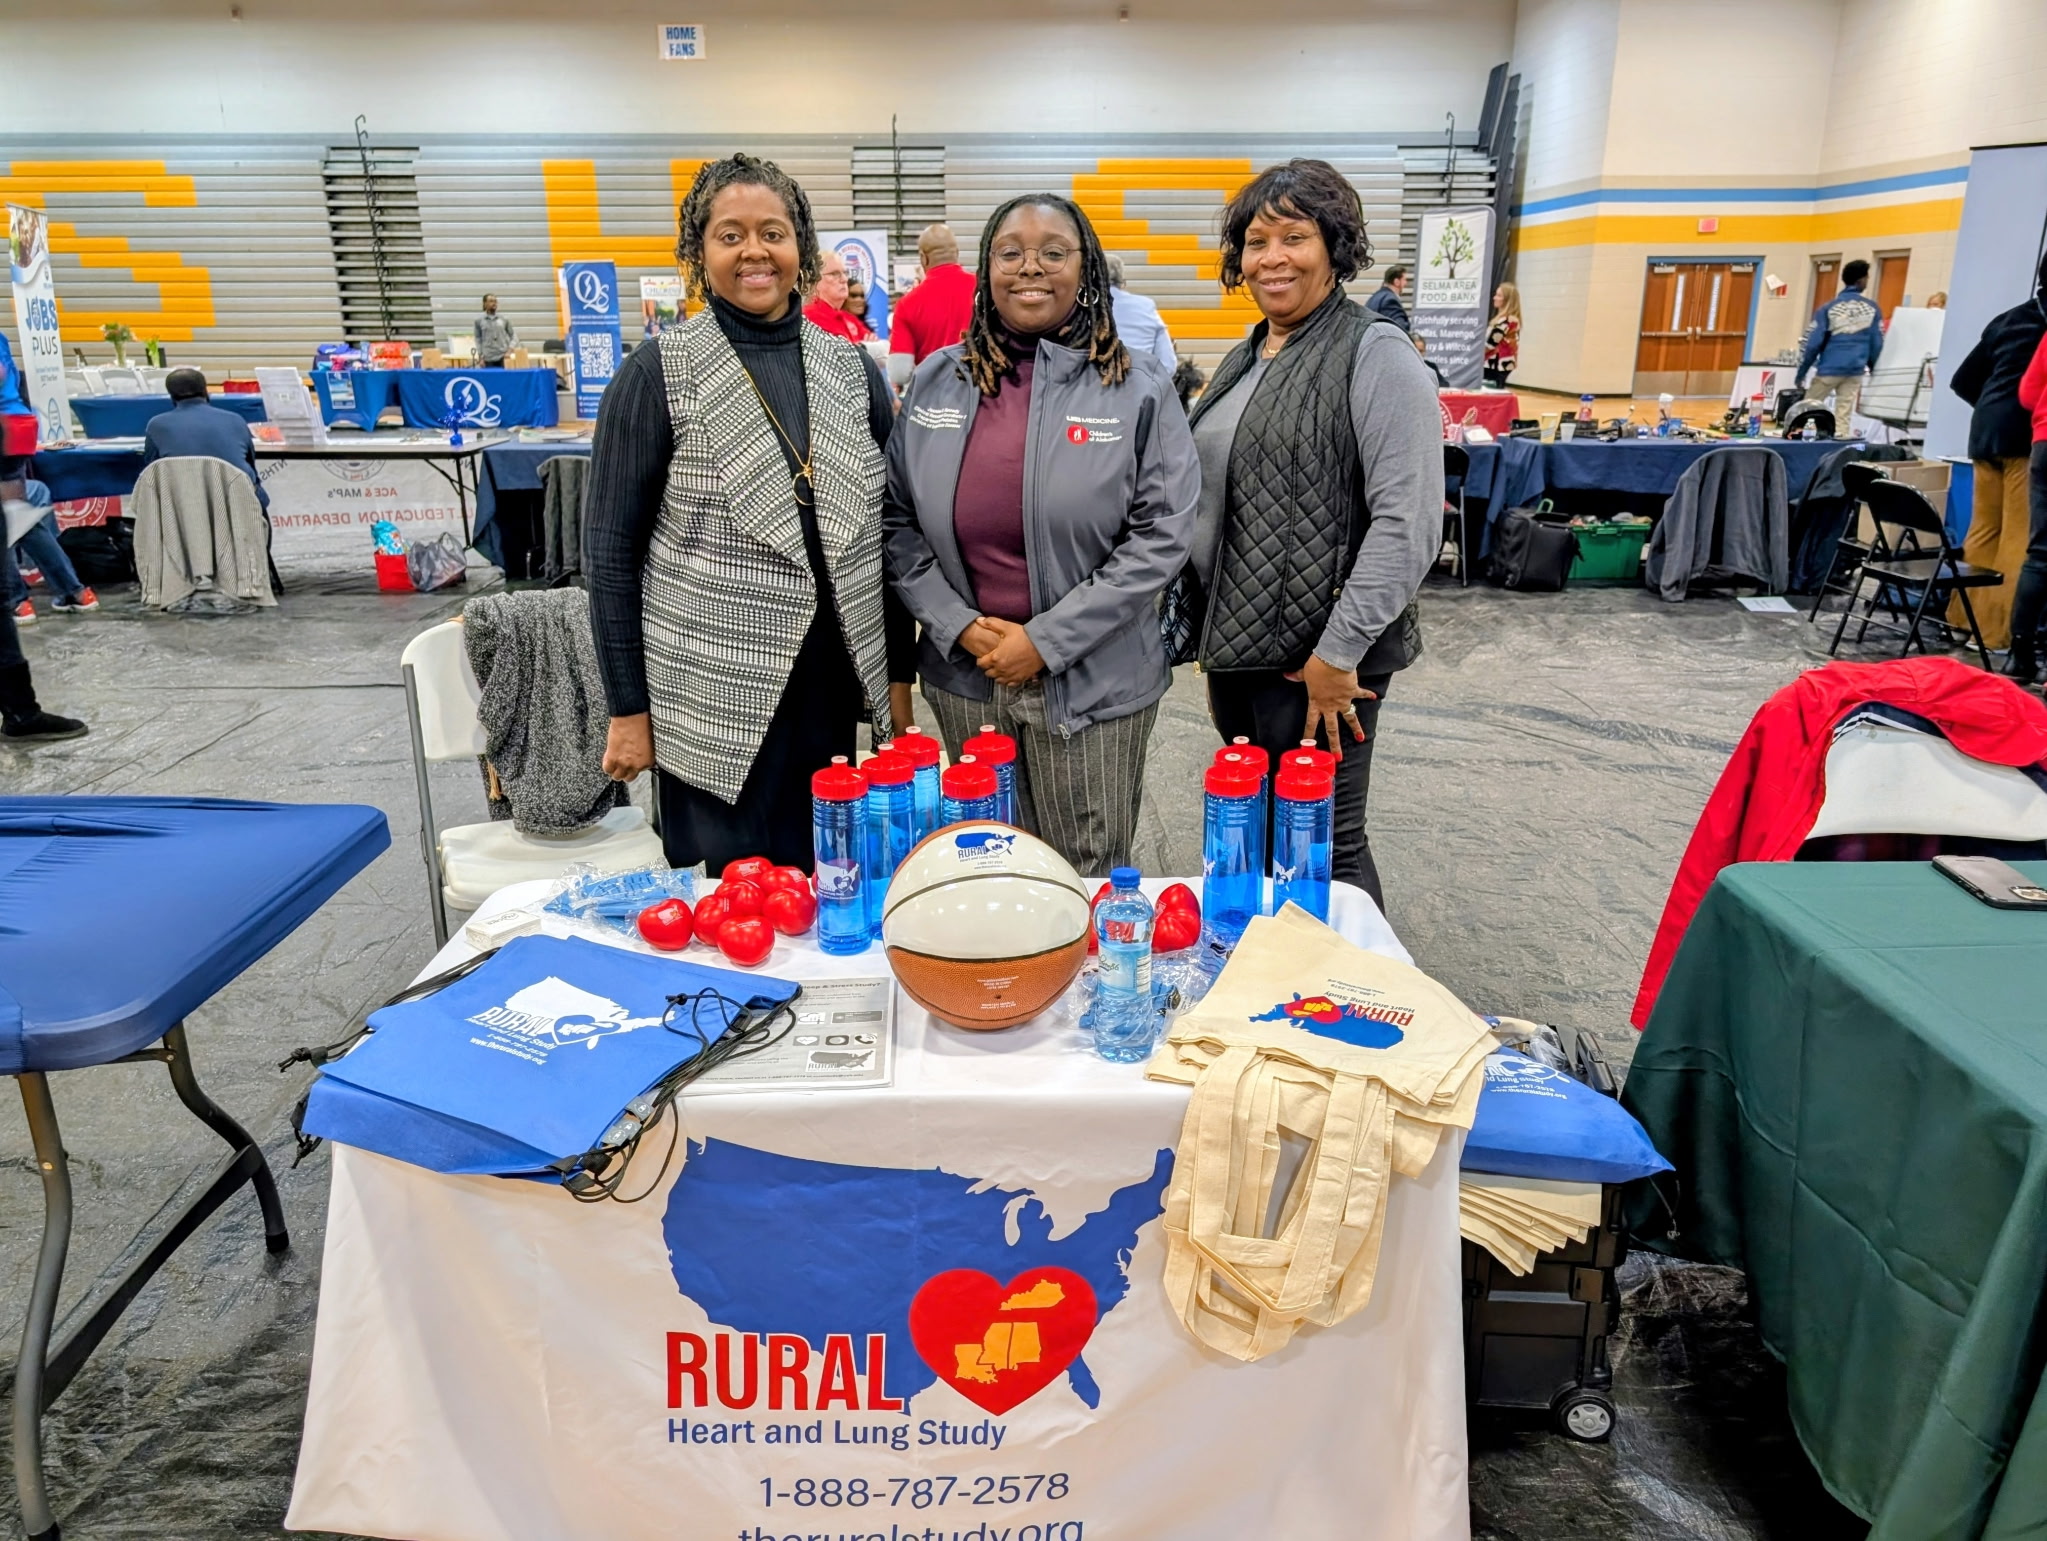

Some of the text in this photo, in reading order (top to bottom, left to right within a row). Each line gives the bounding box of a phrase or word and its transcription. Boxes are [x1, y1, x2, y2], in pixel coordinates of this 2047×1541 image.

[666, 26, 696, 40] HOME
[669, 43, 696, 57] FANS
[1422, 280, 1477, 290] SELMA AREA
[1421, 292, 1476, 302] FOOD BANK
[25, 297, 58, 331] JOBS
[1413, 315, 1479, 327] Faithfully serving
[32, 336, 58, 356] PLUS
[1324, 991, 1349, 1001] Study
[1349, 997, 1370, 1006] Lung
[1345, 1002, 1415, 1027] RURAL
[1390, 1005, 1415, 1014] Heart
[472, 1006, 554, 1037] RURAL
[665, 1331, 904, 1412] RURAL
[668, 1418, 1007, 1451] Heart and Lung Study
[760, 1473, 1070, 1510] 1-888-787-2578
